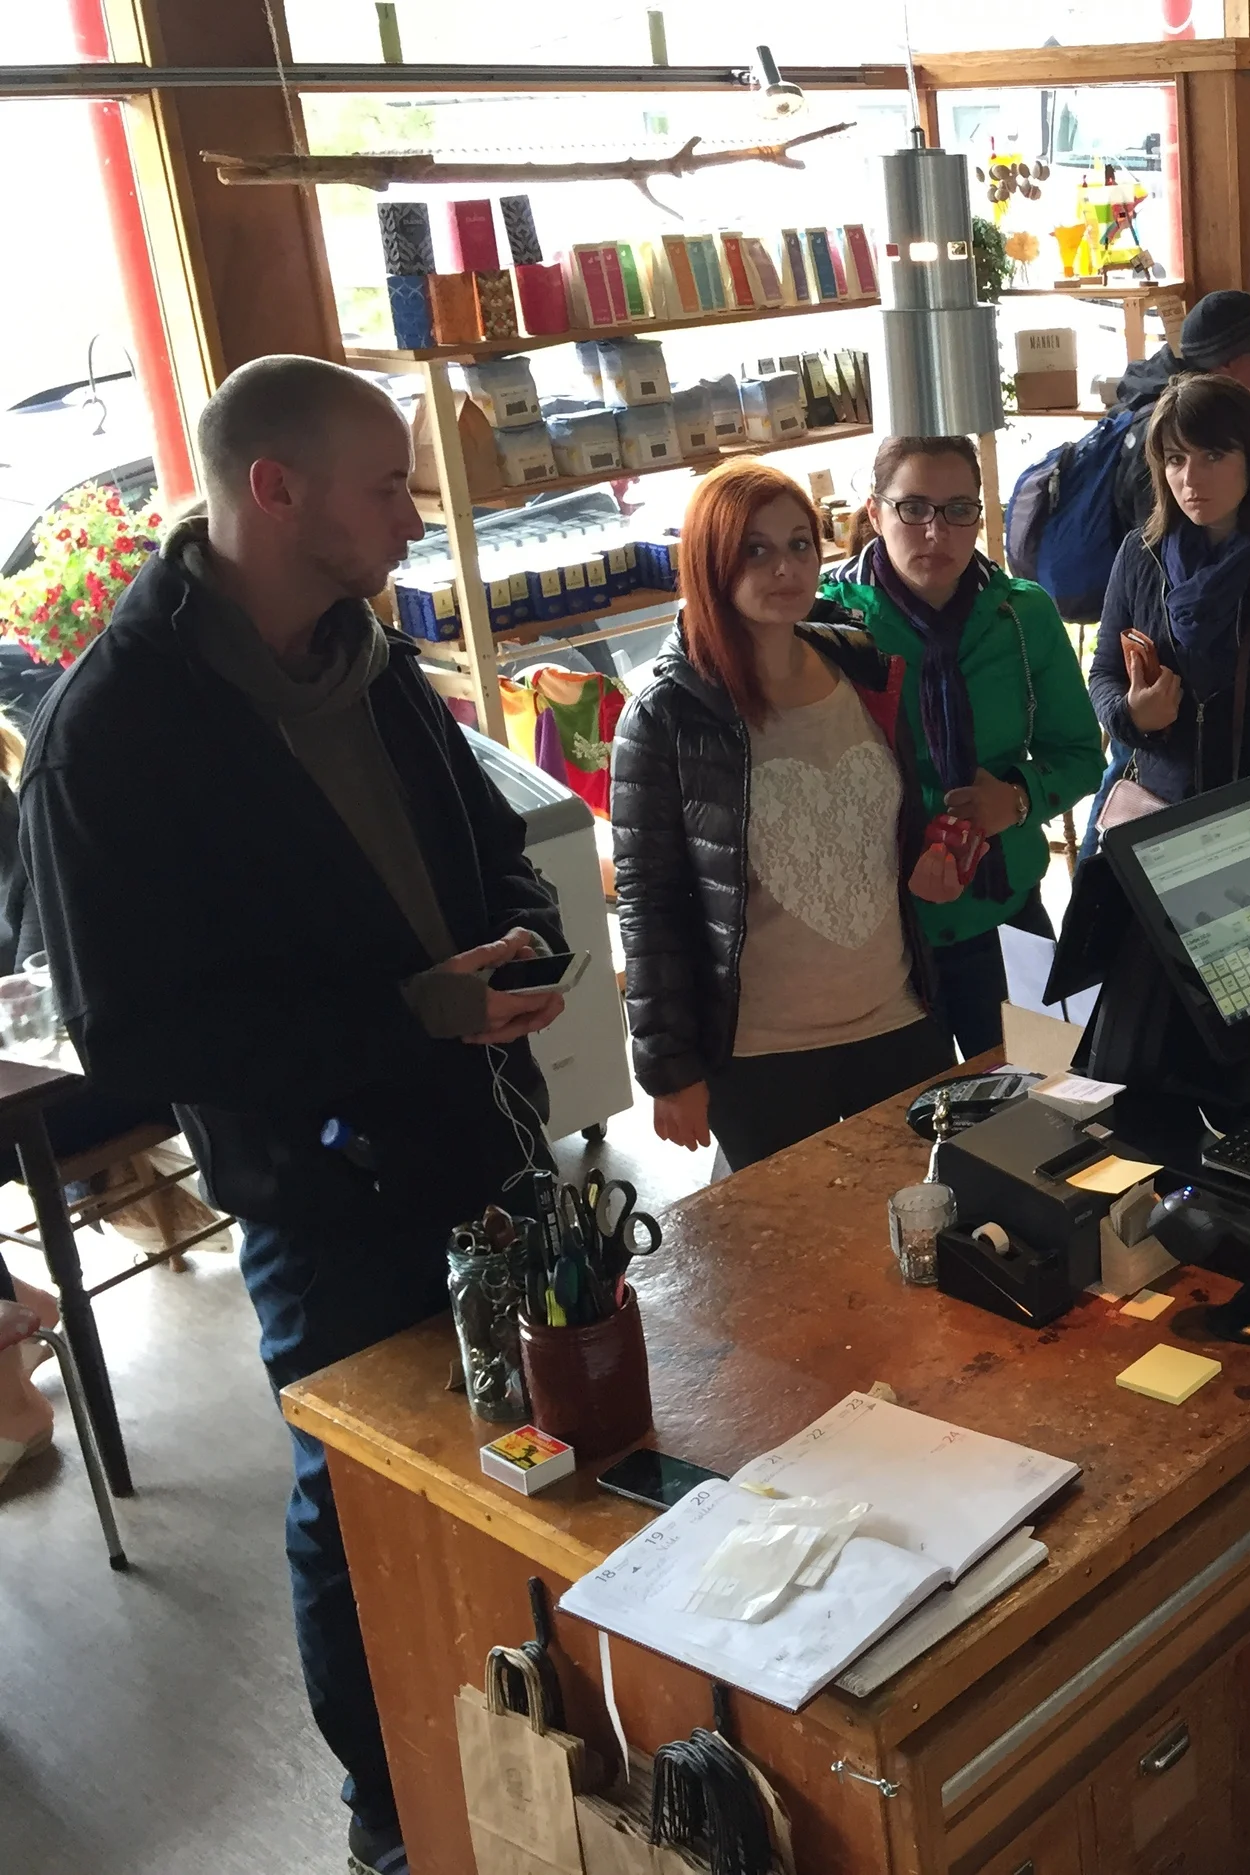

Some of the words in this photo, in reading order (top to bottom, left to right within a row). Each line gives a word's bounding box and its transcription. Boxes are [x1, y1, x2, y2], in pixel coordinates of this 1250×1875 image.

[846, 1398, 864, 1411] 23
[806, 1428, 826, 1441] 22
[765, 1454, 783, 1465] 21
[690, 1490, 711, 1506] 20
[644, 1530, 664, 1545] 19
[594, 1568, 616, 1583] 18
